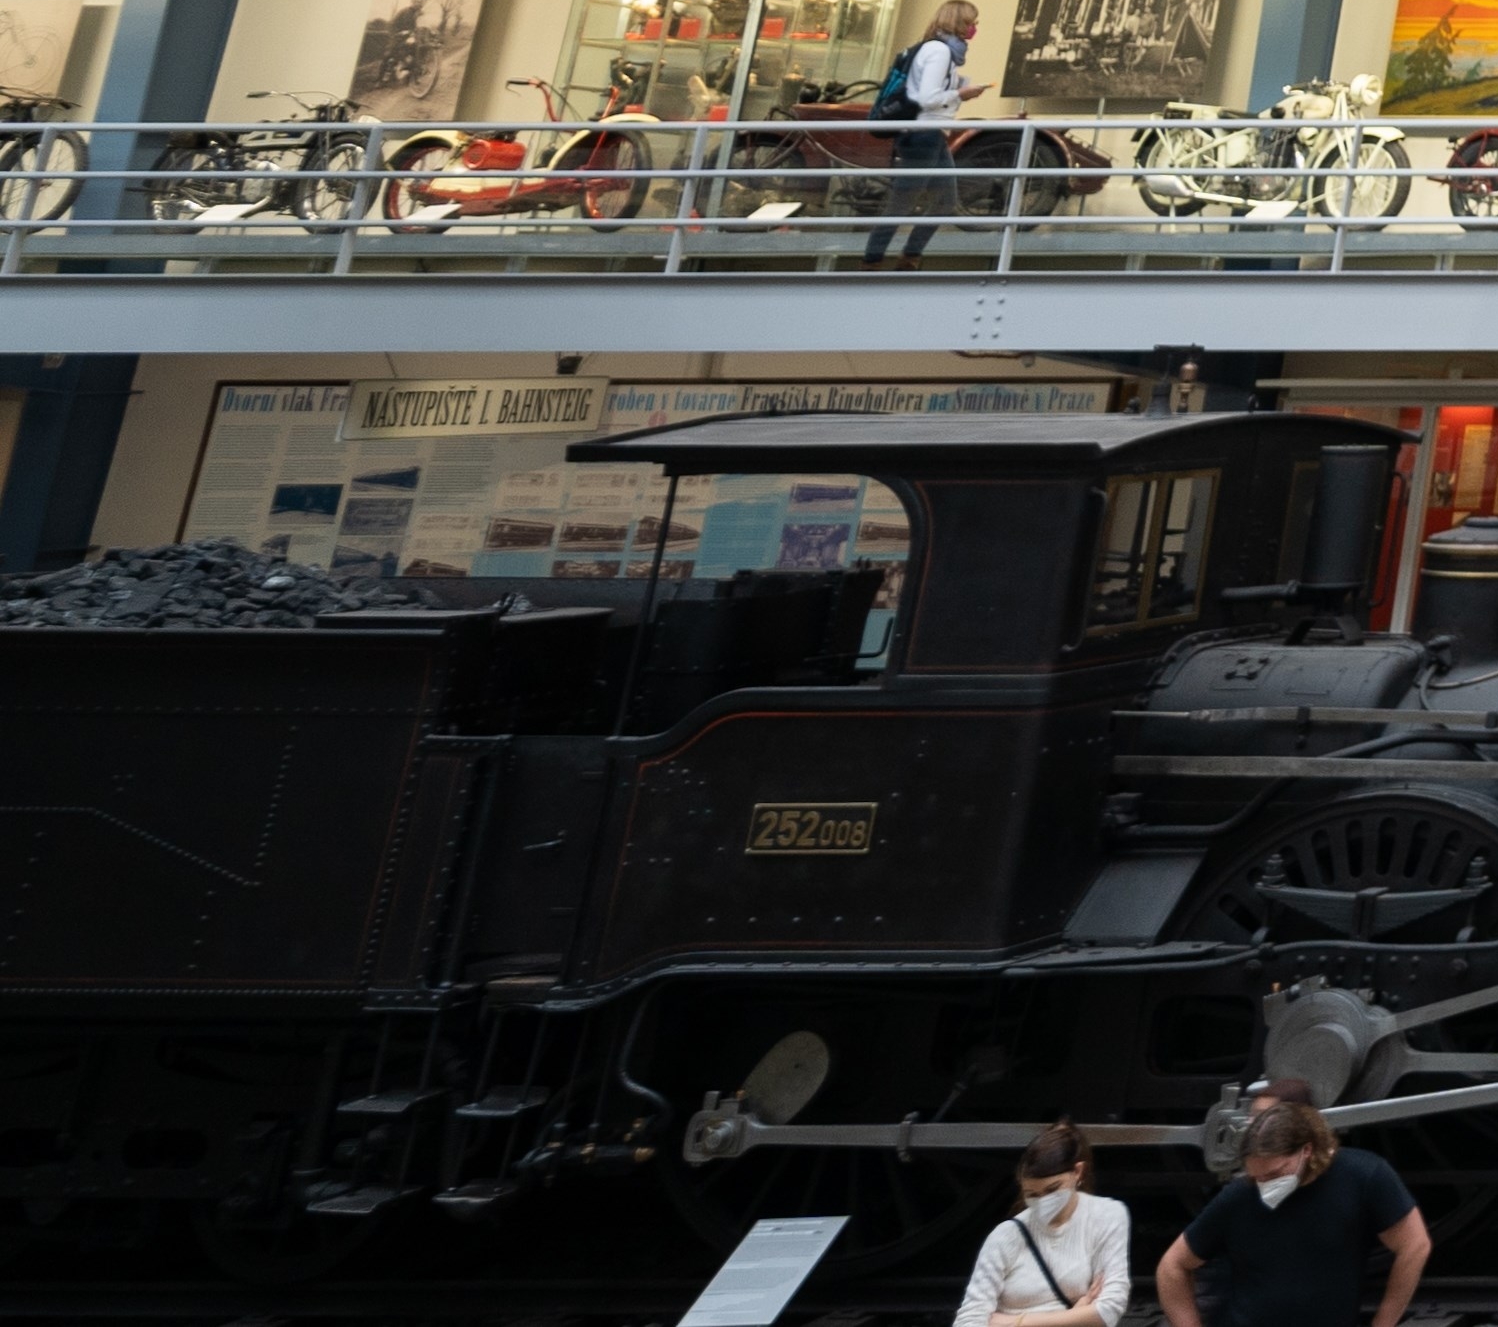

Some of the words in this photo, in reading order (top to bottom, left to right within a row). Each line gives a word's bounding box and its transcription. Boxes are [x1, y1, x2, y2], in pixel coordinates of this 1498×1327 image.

[280, 387, 315, 413] vlak
[319, 387, 349, 413] Fra
[828, 385, 924, 413] Ringhoffera
[927, 393, 949, 412] na
[1047, 385, 1096, 412] Praze
[361, 386, 478, 428] NÁSTUPIŠTĚ
[495, 387, 594, 425] BAHNSTEIG
